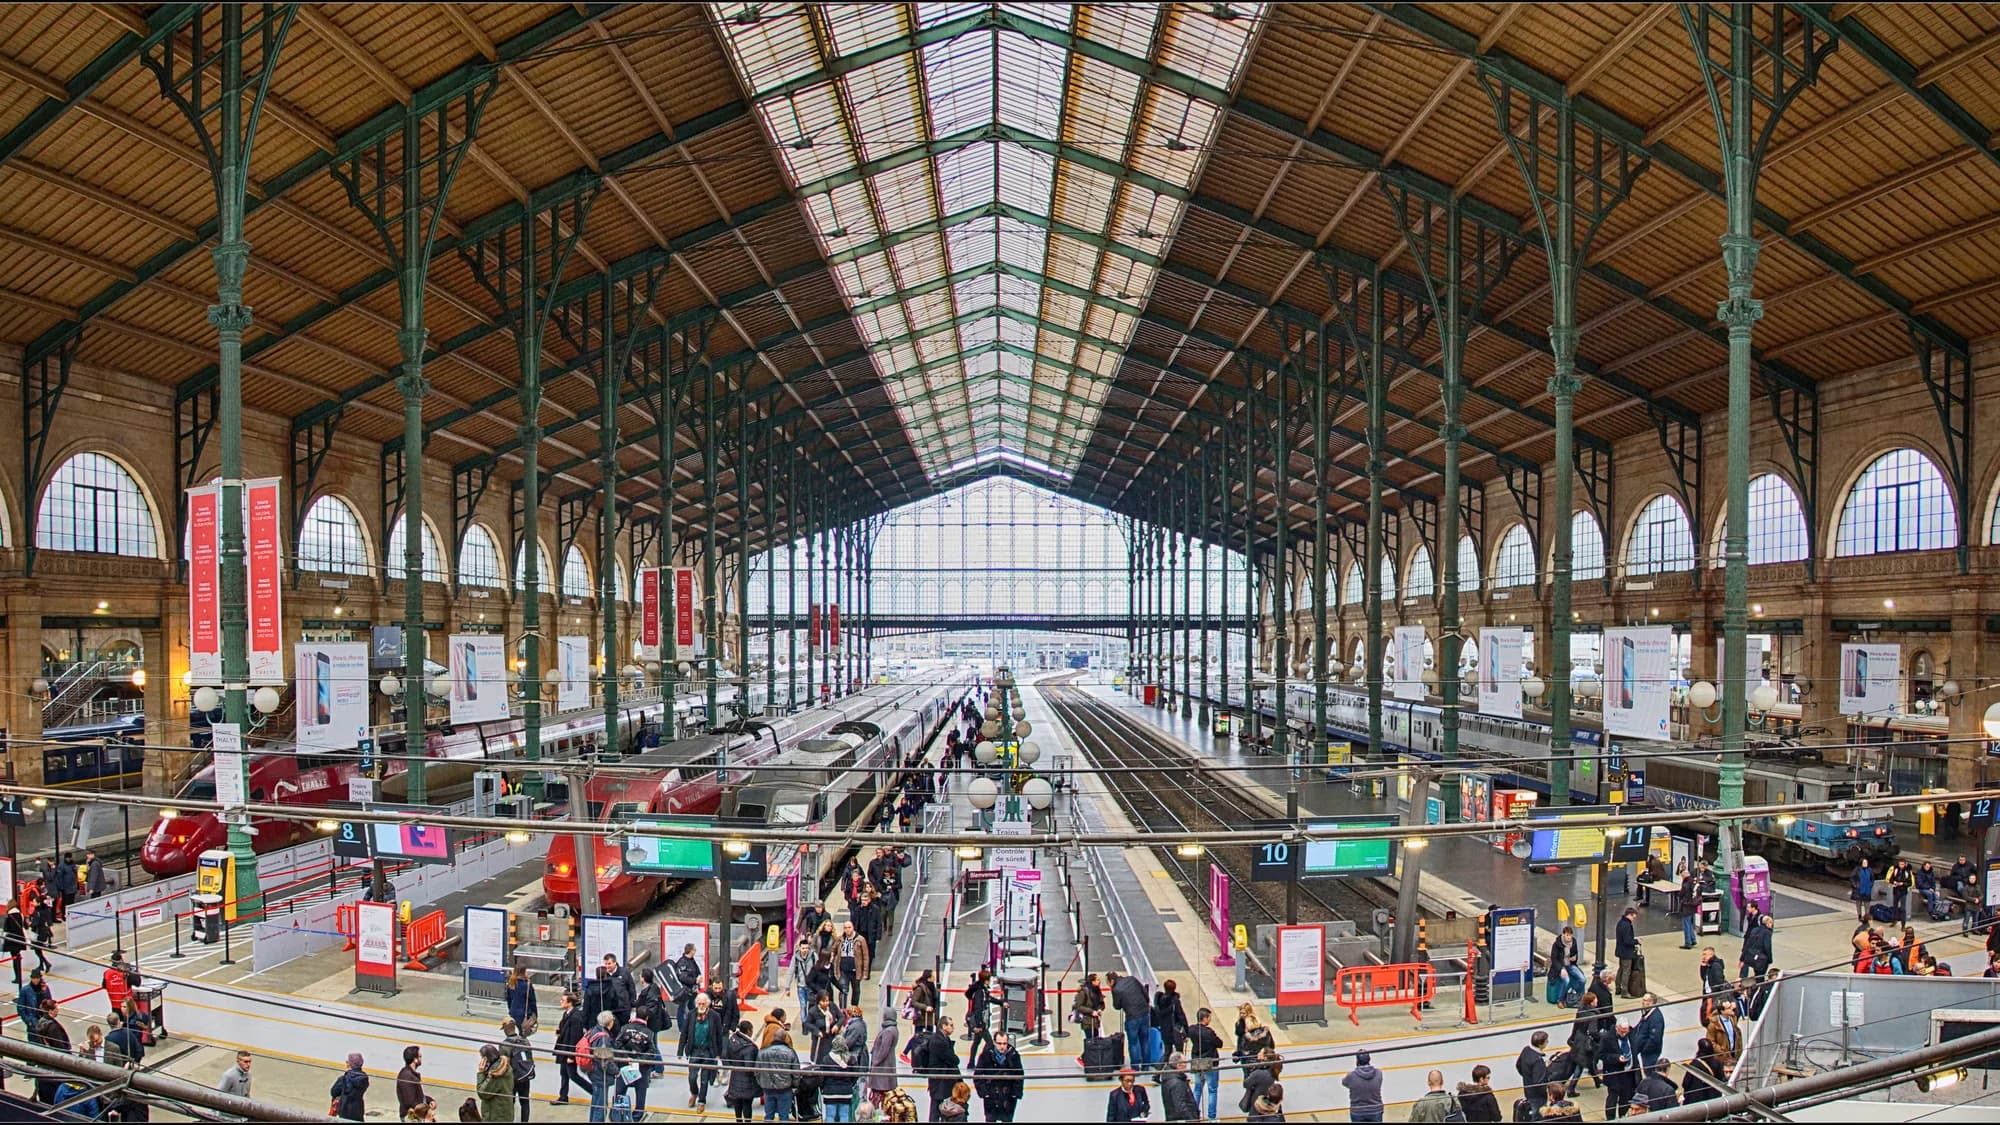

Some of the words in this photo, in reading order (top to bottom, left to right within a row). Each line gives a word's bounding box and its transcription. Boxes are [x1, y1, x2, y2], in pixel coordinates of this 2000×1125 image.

[301, 778, 328, 792] THALYS
[1976, 799, 1991, 814] 12
[342, 822, 354, 840] 8
[1625, 826, 1645, 845] 11
[1261, 842, 1289, 862] 10
